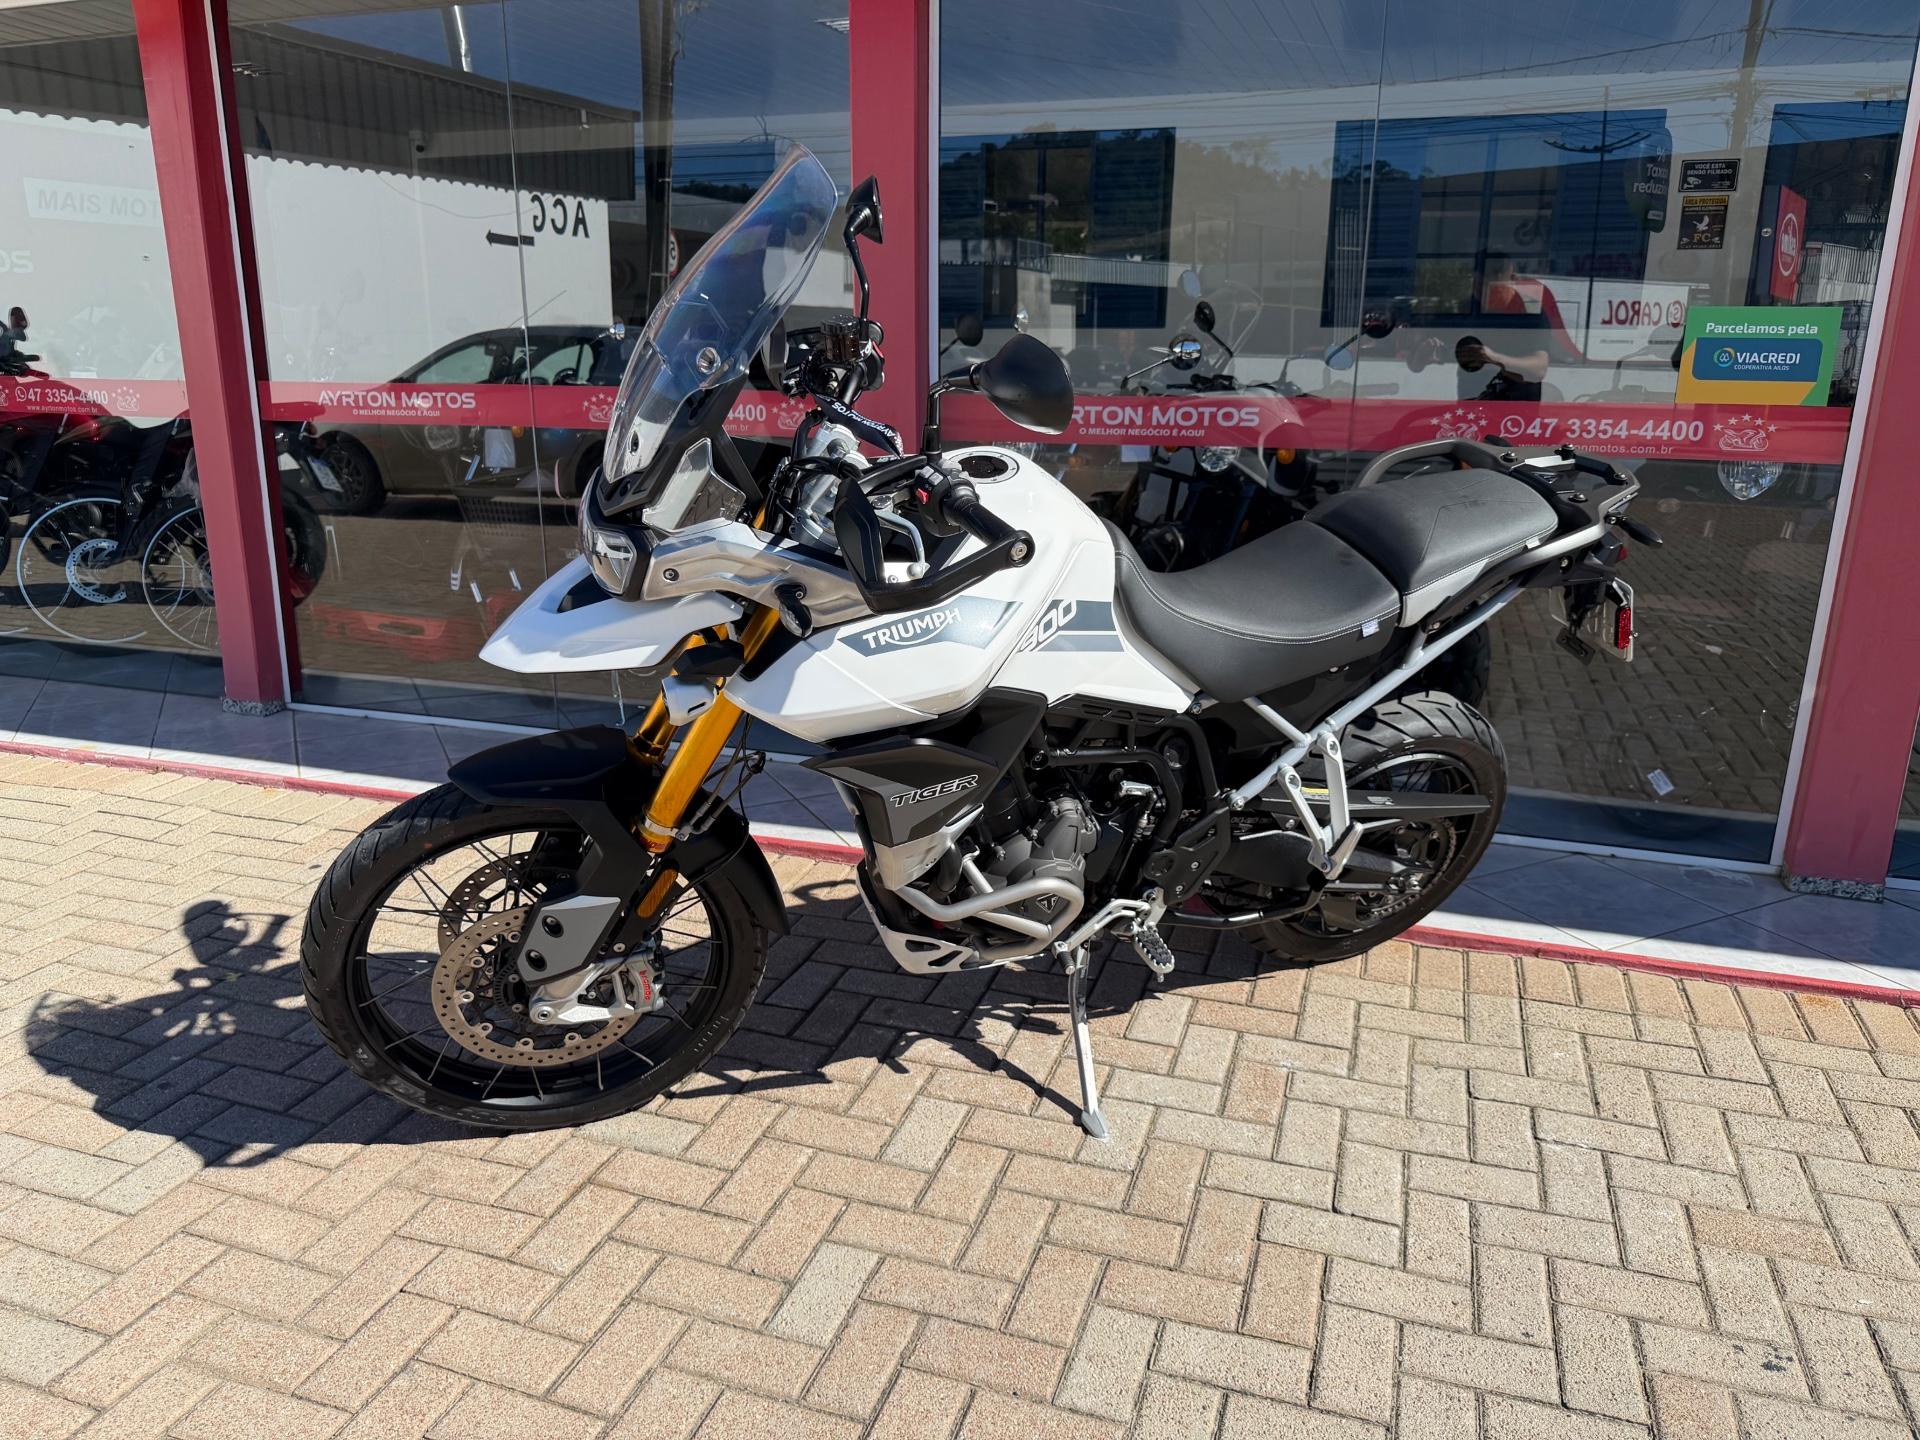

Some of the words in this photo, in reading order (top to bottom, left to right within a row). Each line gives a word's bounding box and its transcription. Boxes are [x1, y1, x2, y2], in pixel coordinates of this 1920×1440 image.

[37, 189, 102, 214] MAIS
[1705, 322, 1785, 334] Parcelamos
[1788, 323, 1818, 336] pela
[1736, 352, 1801, 365] VIACREDI
[27, 388, 42, 402] 47
[45, 388, 109, 405] 3354-4400
[318, 390, 396, 408] AYRTON
[401, 391, 477, 409] MOTOS
[1151, 405, 1261, 427] MOTOS
[1079, 427, 1087, 435] O
[1088, 427, 1126, 436] MELHOR
[1127, 427, 1170, 437] NEGÓCIO
[1179, 428, 1205, 438] AQUI
[1526, 418, 1558, 438] 47
[1566, 418, 1704, 441] 3354-4400
[862, 607, 962, 649] TRIUMPH
[890, 774, 978, 807] TIGER
